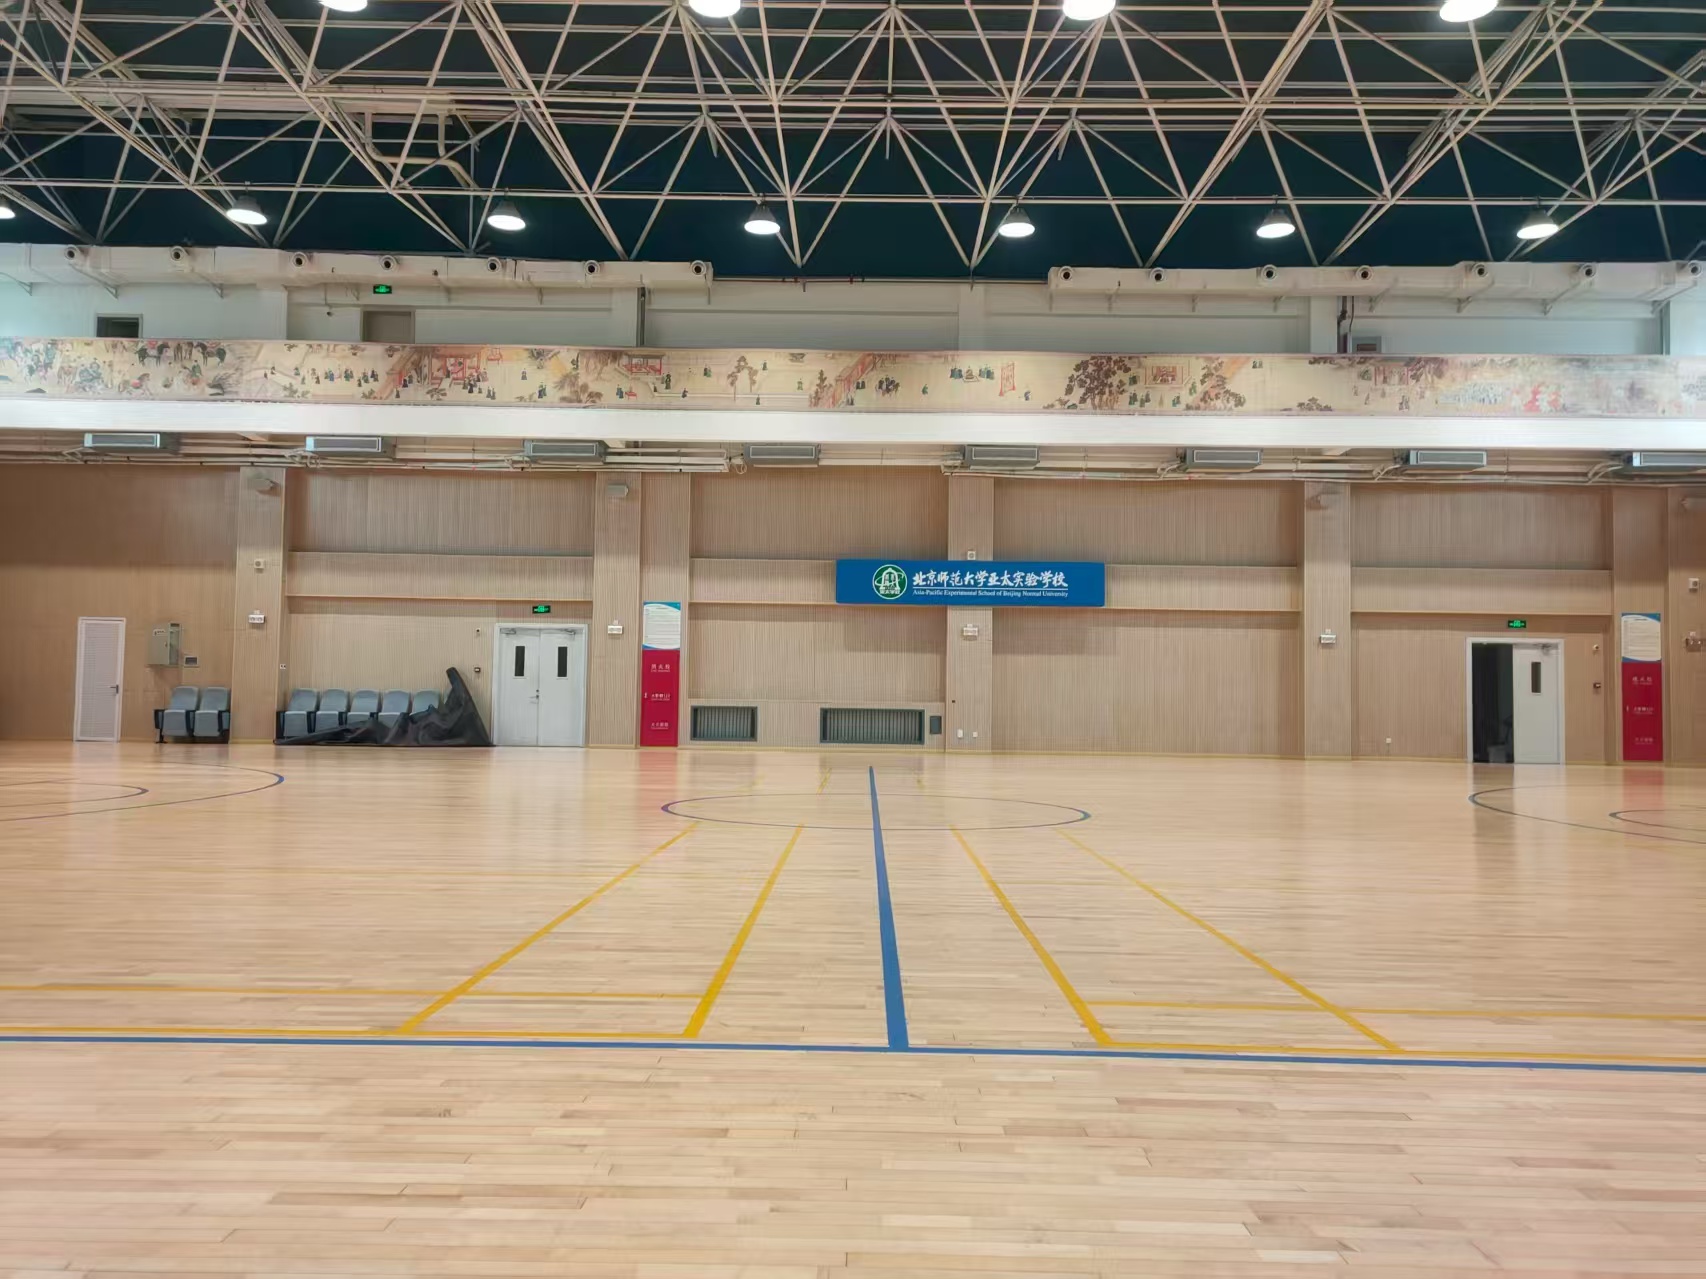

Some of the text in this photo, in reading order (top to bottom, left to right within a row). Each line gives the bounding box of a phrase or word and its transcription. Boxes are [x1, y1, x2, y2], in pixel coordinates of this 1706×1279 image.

[912, 569, 1068, 588] 北京师范大学亚太实验学校
[944, 589, 977, 597] Experimental
